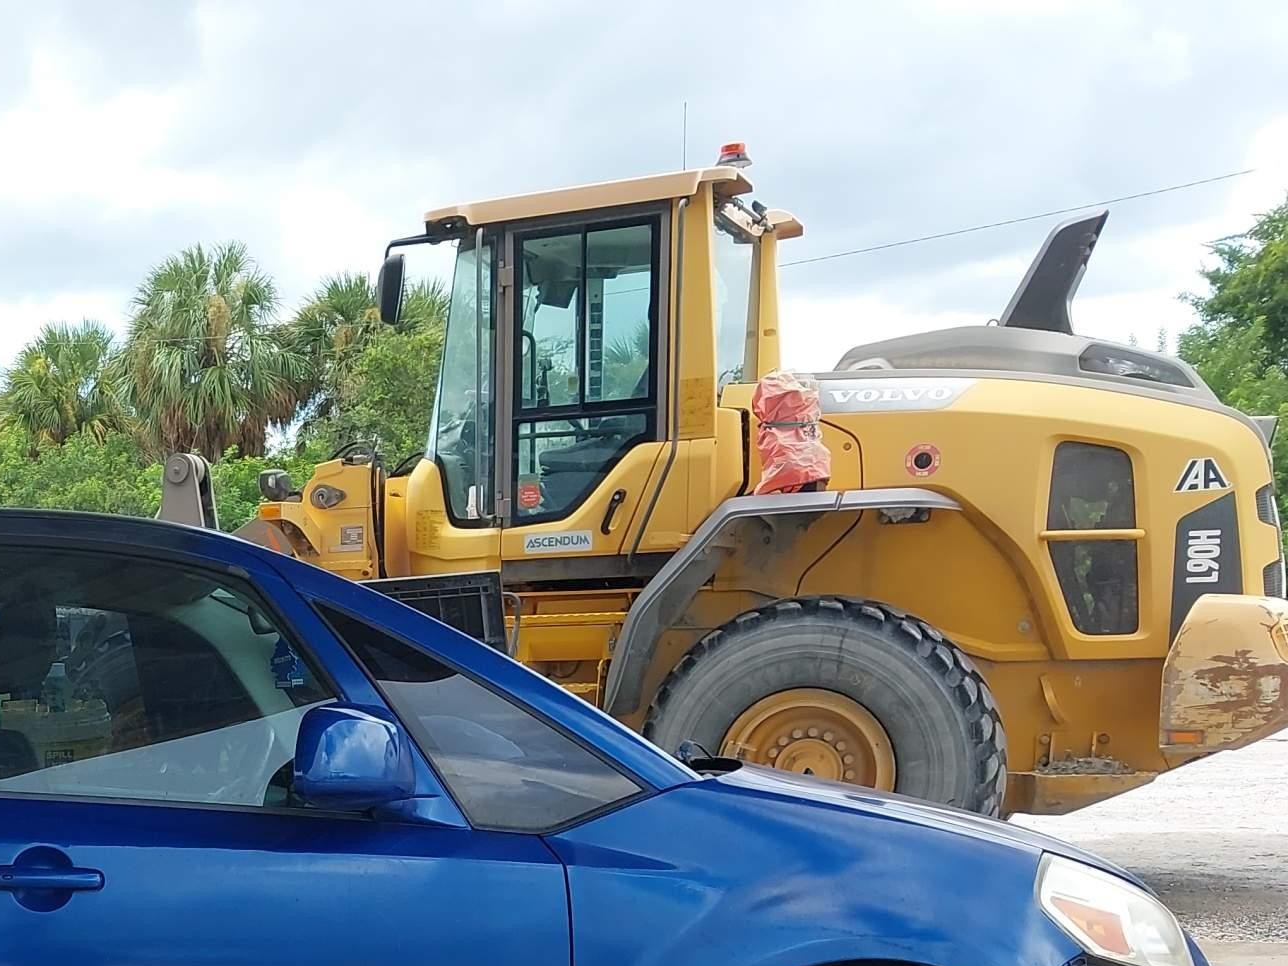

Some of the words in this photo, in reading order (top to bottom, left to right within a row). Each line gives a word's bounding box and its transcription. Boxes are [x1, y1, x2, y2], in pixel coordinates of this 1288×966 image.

[828, 386, 954, 404] VOLVO
[526, 535, 591, 550] ASCENDUM
[1186, 529, 1222, 584] L90H
